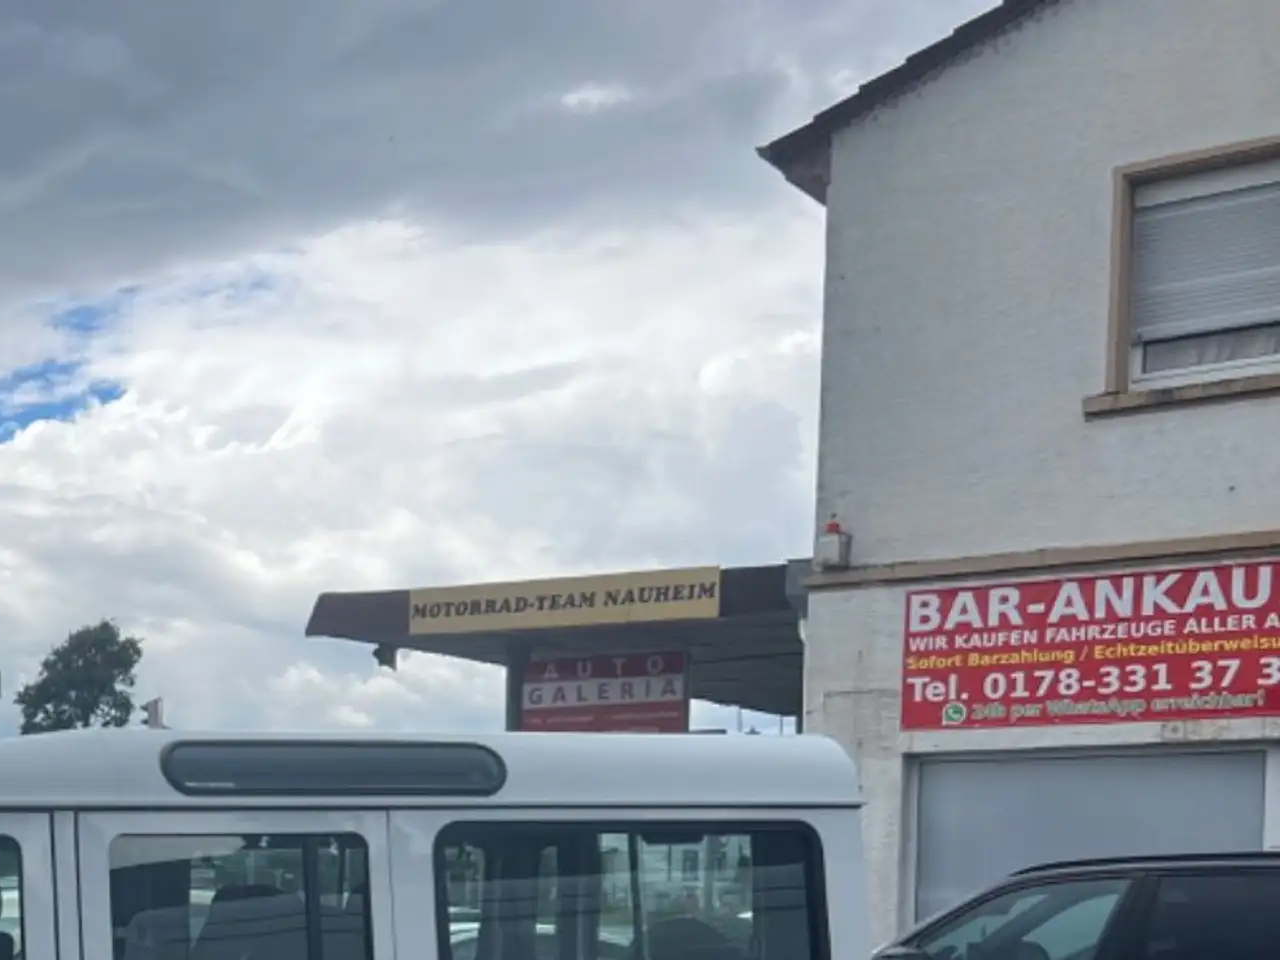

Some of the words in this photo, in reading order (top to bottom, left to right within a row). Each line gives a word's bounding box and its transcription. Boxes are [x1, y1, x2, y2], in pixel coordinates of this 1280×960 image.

[412, 591, 596, 619] MOTORRAD-TEAM
[603, 582, 717, 607] NAUHEIM
[908, 565, 1273, 633] BAR-ANKAU
[908, 634, 949, 653] WIR
[954, 628, 1038, 649] KAUFEN
[1045, 619, 1177, 644] FAHRZEUGE
[1182, 613, 1257, 634] ALLER
[542, 655, 664, 679] AUTO
[906, 654, 962, 670] Sofort
[967, 647, 1076, 667] Barzahlung
[1079, 645, 1089, 661] /
[528, 679, 677, 706] GALERIA
[906, 672, 970, 702] Tel.
[983, 662, 1173, 700] 0178-331
[1188, 658, 1241, 690] 37
